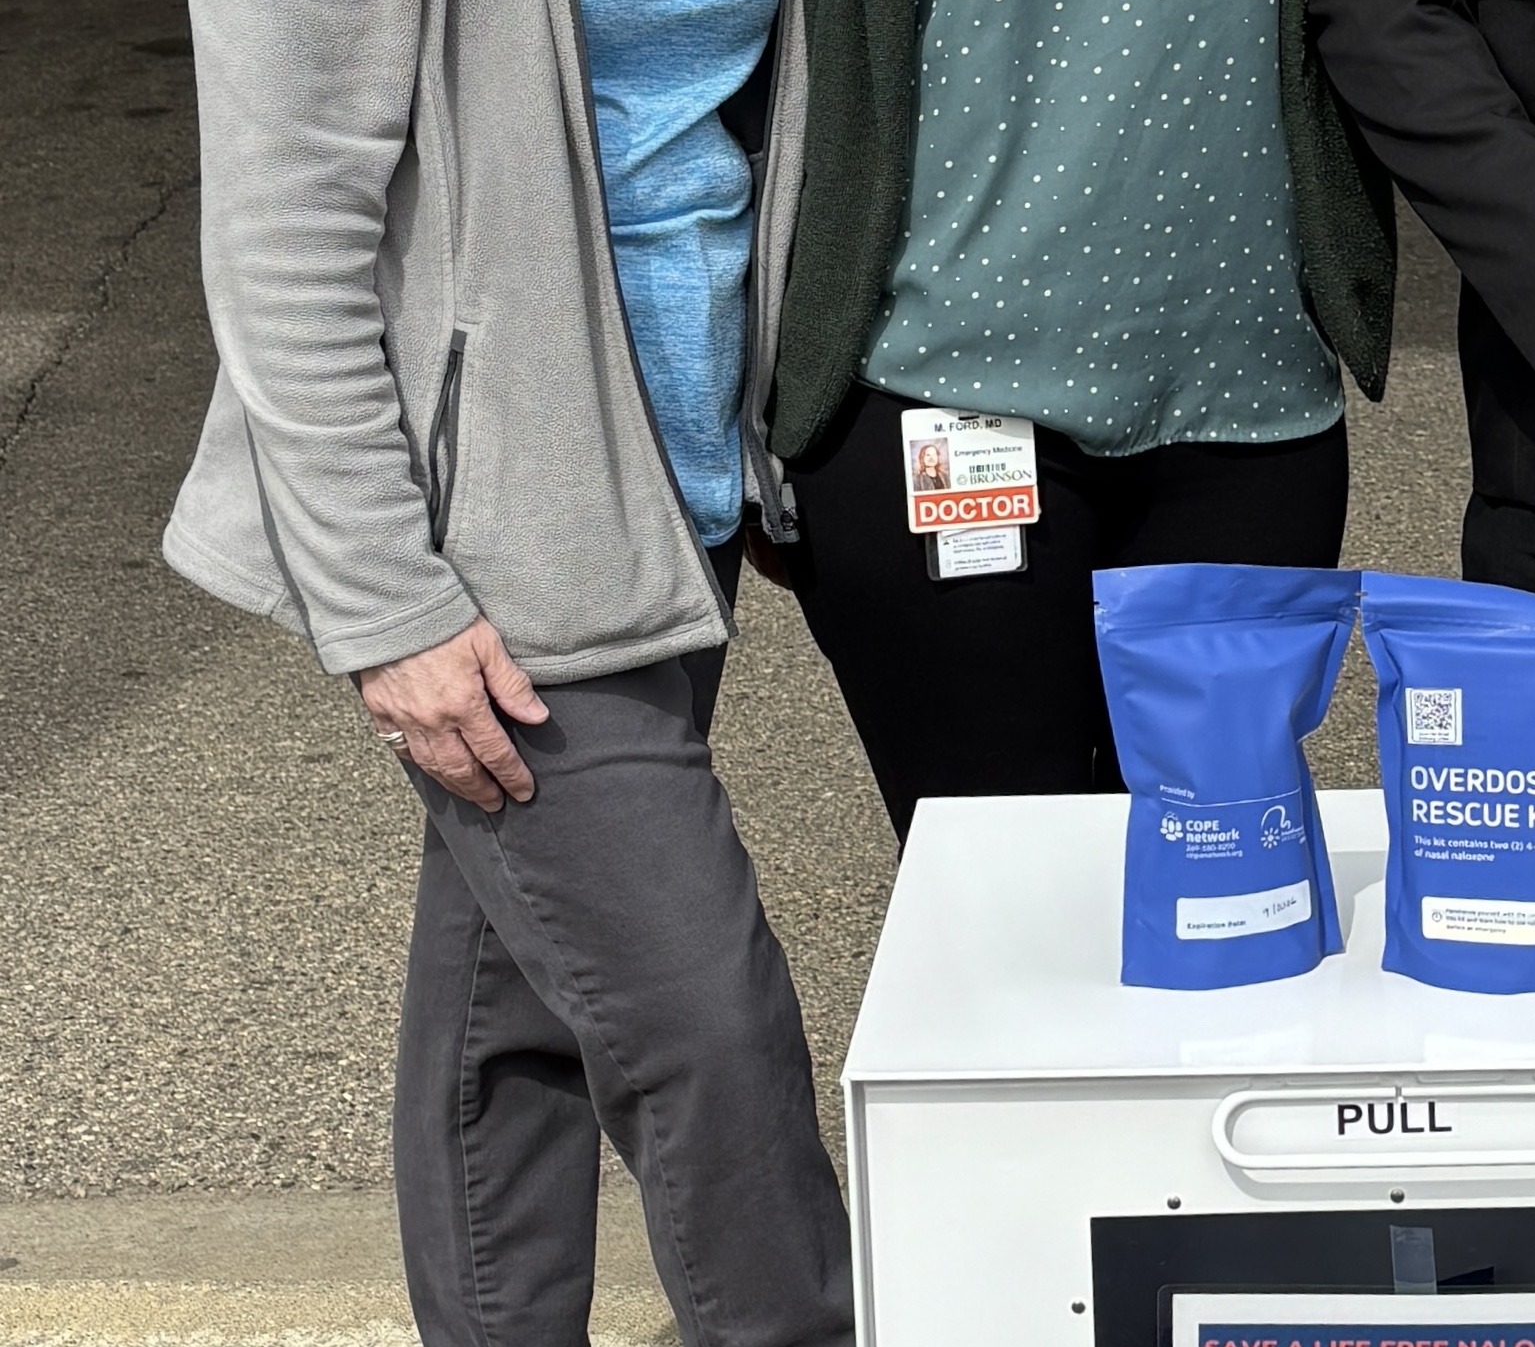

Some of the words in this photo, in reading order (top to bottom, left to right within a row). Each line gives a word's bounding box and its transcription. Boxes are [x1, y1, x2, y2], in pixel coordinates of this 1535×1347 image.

[934, 424, 946, 432] M.
[985, 419, 1002, 428] MD
[955, 449, 991, 457] Emergency
[970, 470, 1032, 485] BRONSON
[919, 495, 1030, 523] DOCTOR
[1412, 799, 1520, 828] RESCUE
[1186, 820, 1220, 831] COPE
[1186, 828, 1240, 843] network
[1414, 835, 1431, 846] This
[1433, 837, 1445, 847] kit
[1448, 838, 1488, 848] contains
[1490, 840, 1508, 849] two
[1414, 849, 1423, 857] of
[1425, 850, 1449, 860] nasal
[1451, 852, 1494, 861] naloxone
[1338, 1101, 1452, 1135] PULL
